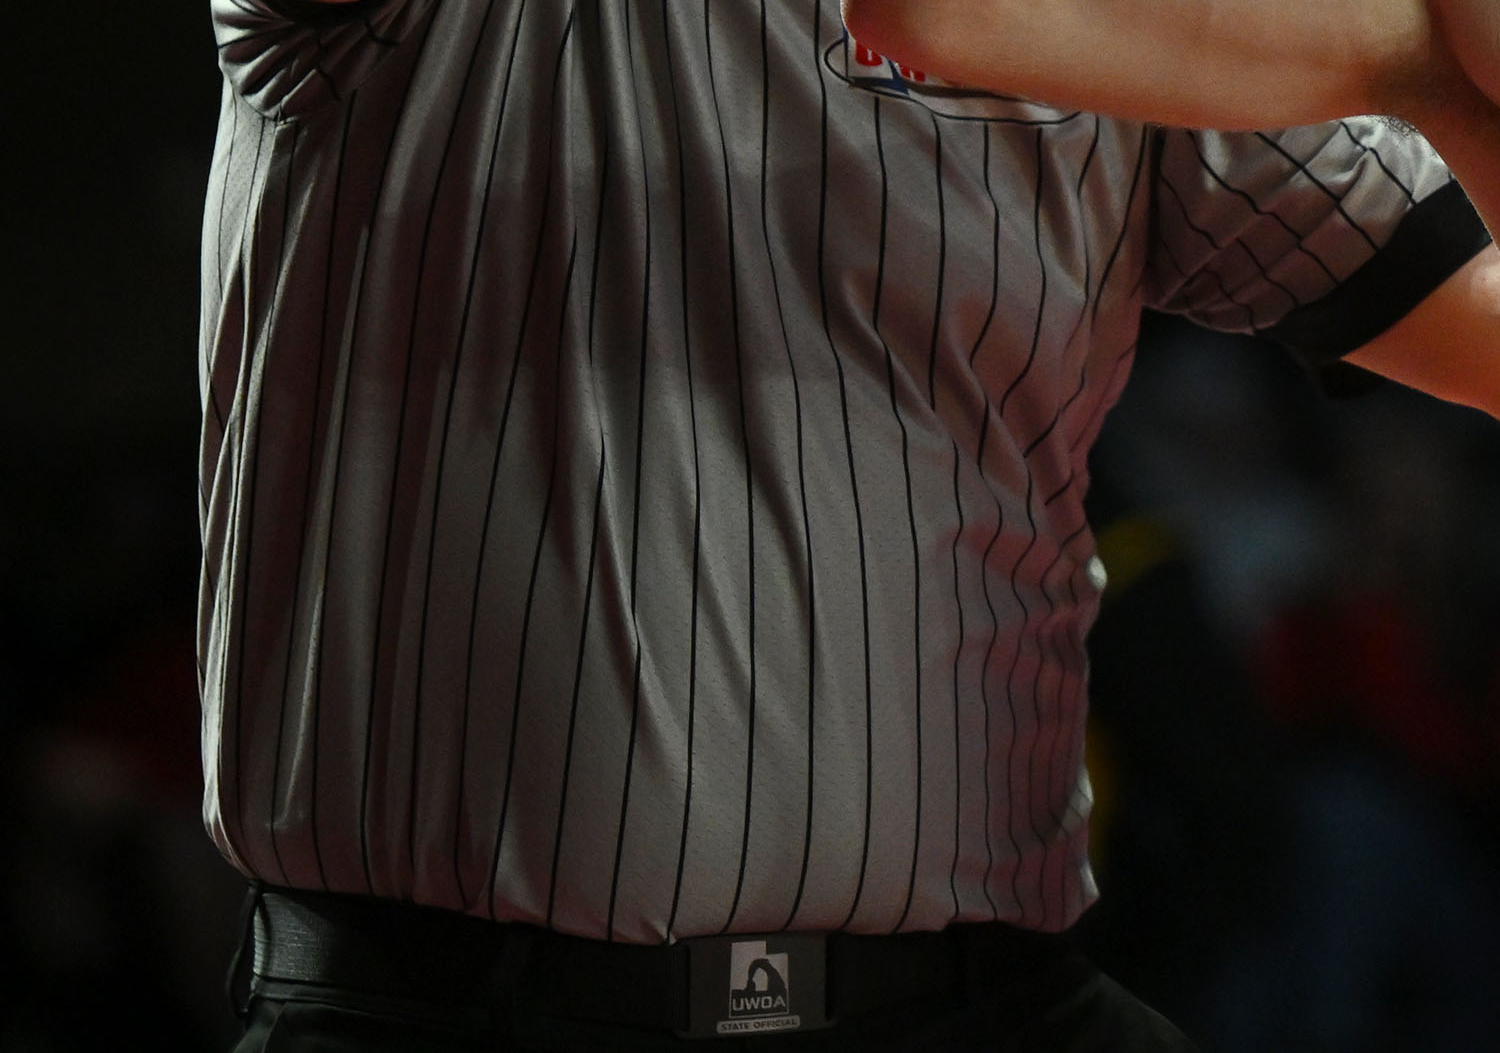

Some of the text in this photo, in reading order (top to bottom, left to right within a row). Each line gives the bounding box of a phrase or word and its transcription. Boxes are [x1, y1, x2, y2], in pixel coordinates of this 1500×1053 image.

[733, 995, 786, 1011] UWOA
[721, 1019, 797, 1031] STATE OFFICIAL
